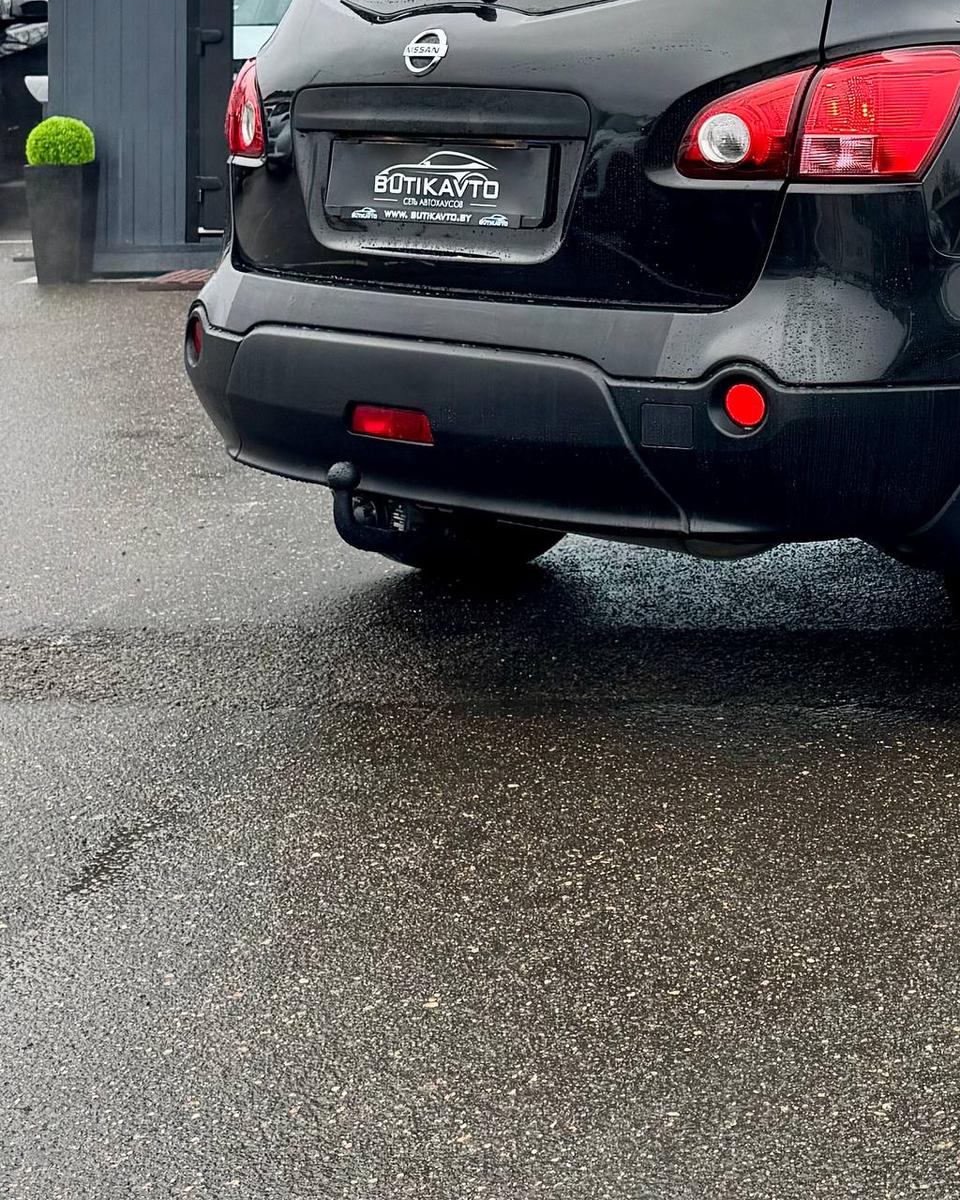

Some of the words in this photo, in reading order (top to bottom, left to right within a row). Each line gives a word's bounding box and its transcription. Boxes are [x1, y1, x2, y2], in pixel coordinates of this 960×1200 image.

[407, 46, 440, 54] NISSAN
[374, 174, 499, 199] BUTIKAVTO
[411, 211, 472, 222] BUTIKAVTO.BY
